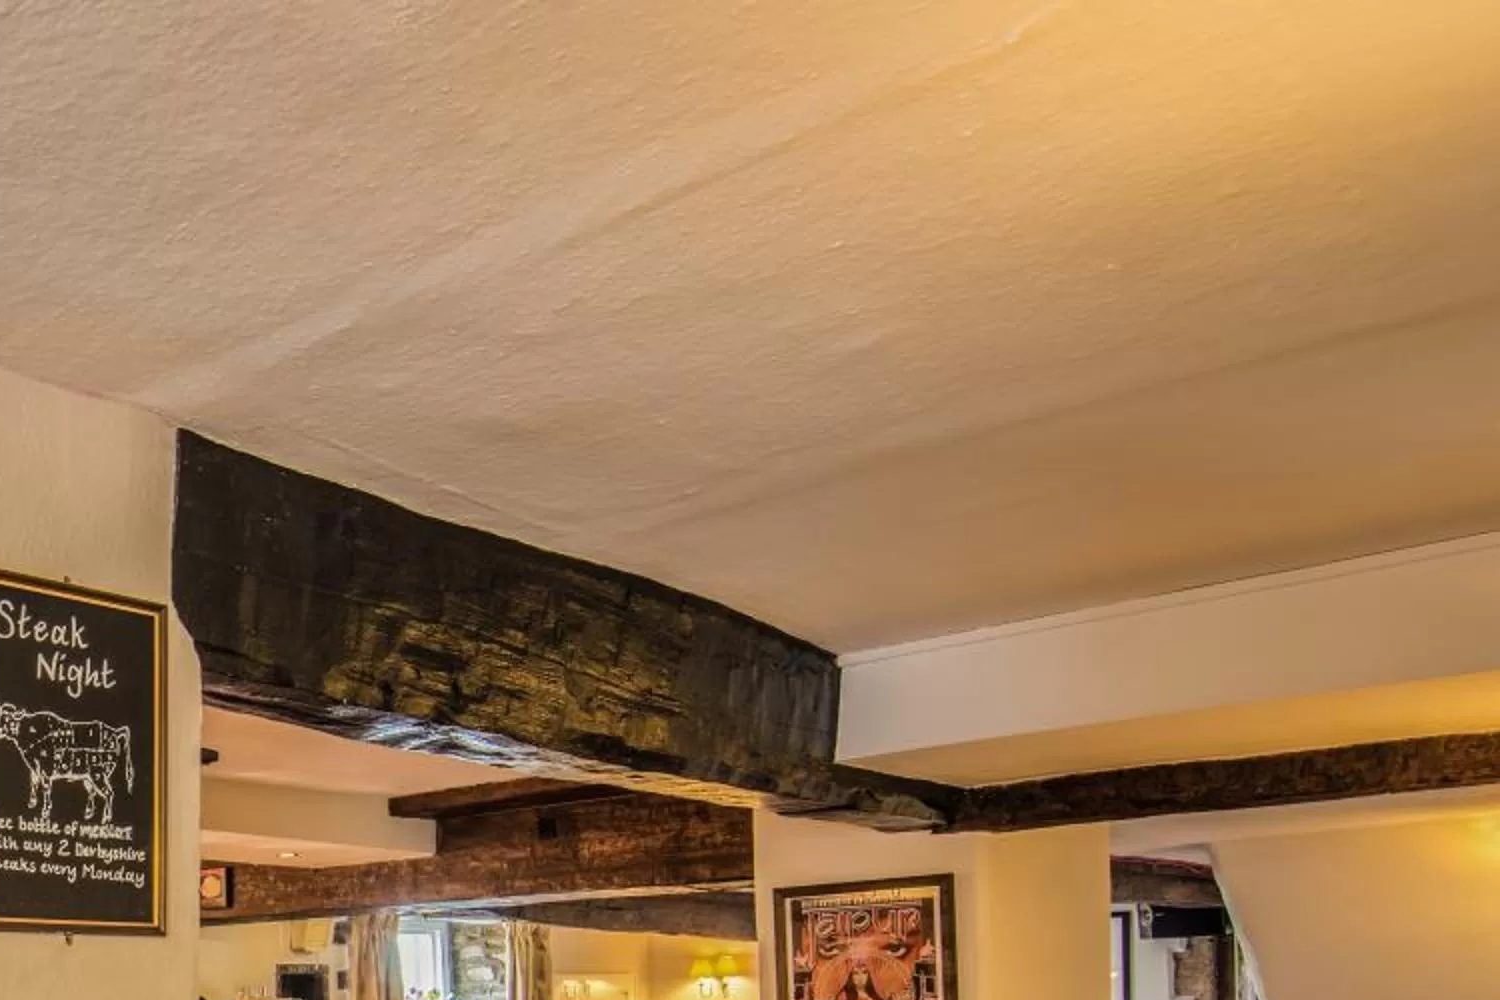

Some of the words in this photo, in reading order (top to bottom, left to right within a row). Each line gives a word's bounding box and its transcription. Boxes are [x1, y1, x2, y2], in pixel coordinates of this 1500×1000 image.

[36, 650, 117, 698] Night
[18, 815, 61, 834] bottle
[63, 820, 79, 837] of
[23, 839, 53, 857] any
[57, 839, 71, 857] 2
[75, 841, 147, 865] Derbyshire
[40, 862, 77, 883] every
[82, 863, 146, 889] Monday
